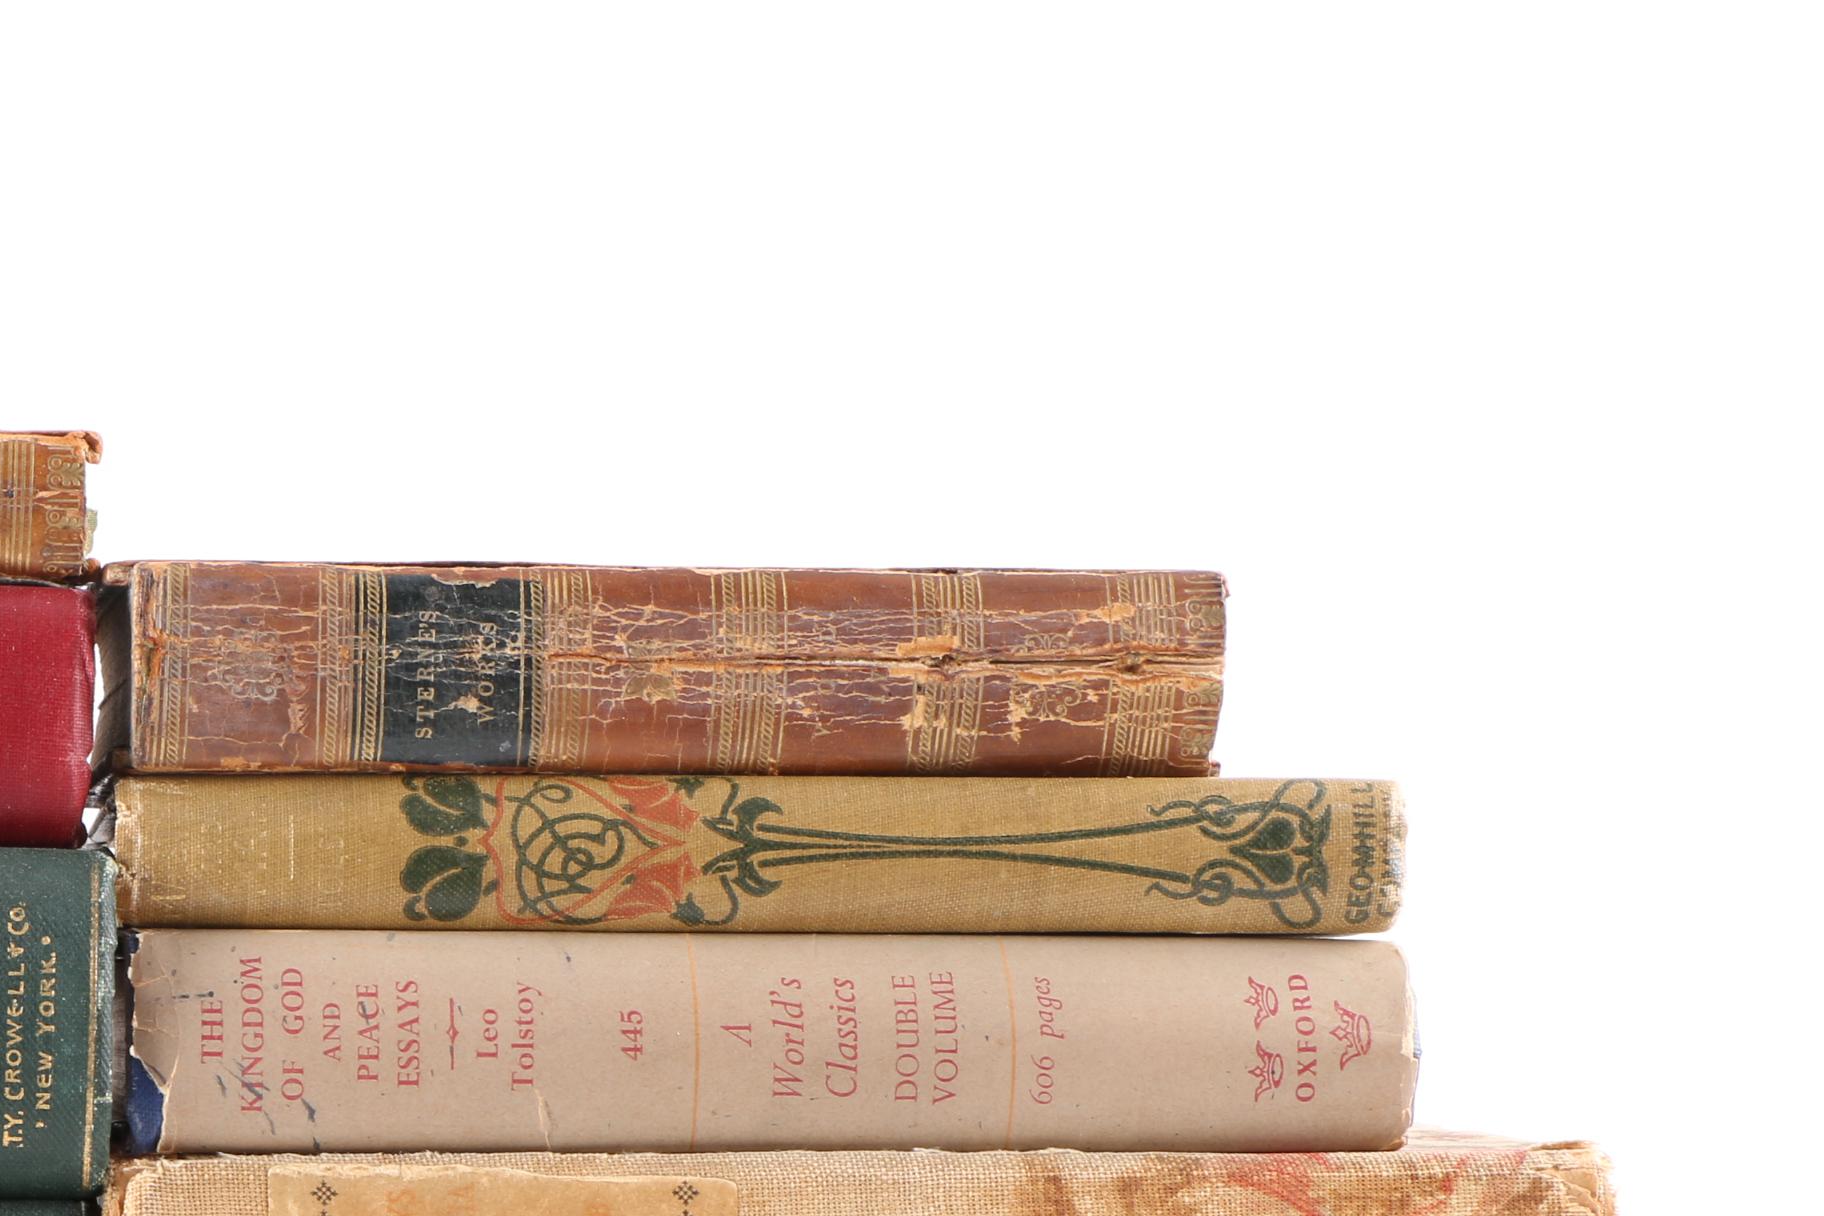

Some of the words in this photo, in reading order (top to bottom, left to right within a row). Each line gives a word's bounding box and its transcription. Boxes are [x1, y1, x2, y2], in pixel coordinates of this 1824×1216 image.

[415, 611, 437, 739] STERNE'S
[478, 623, 497, 726] WORKS
[4, 964, 25, 1101] CROWELL
[200, 999, 224, 1064] THE
[240, 956, 264, 1112] KINGDOM
[281, 967, 305, 1035] GOD
[322, 1002, 341, 1062] AND
[355, 984, 380, 1082] PEACE
[395, 980, 420, 1088] ESSAYS
[476, 1008, 499, 1059] Leo
[511, 981, 543, 1091] Tolstoy
[619, 1009, 644, 1061] 445
[720, 1022, 753, 1048] A
[769, 976, 805, 1099] World's
[825, 977, 859, 1098] Classics
[890, 974, 920, 1103] DOUBLE
[928, 970, 959, 1105] VOLUME
[1034, 976, 1065, 1040] pages
[1287, 974, 1318, 1102] OXFORD
[36, 1052, 54, 1110] NEW
[281, 1059, 304, 1101] OF
[1028, 1054, 1056, 1105] 606
